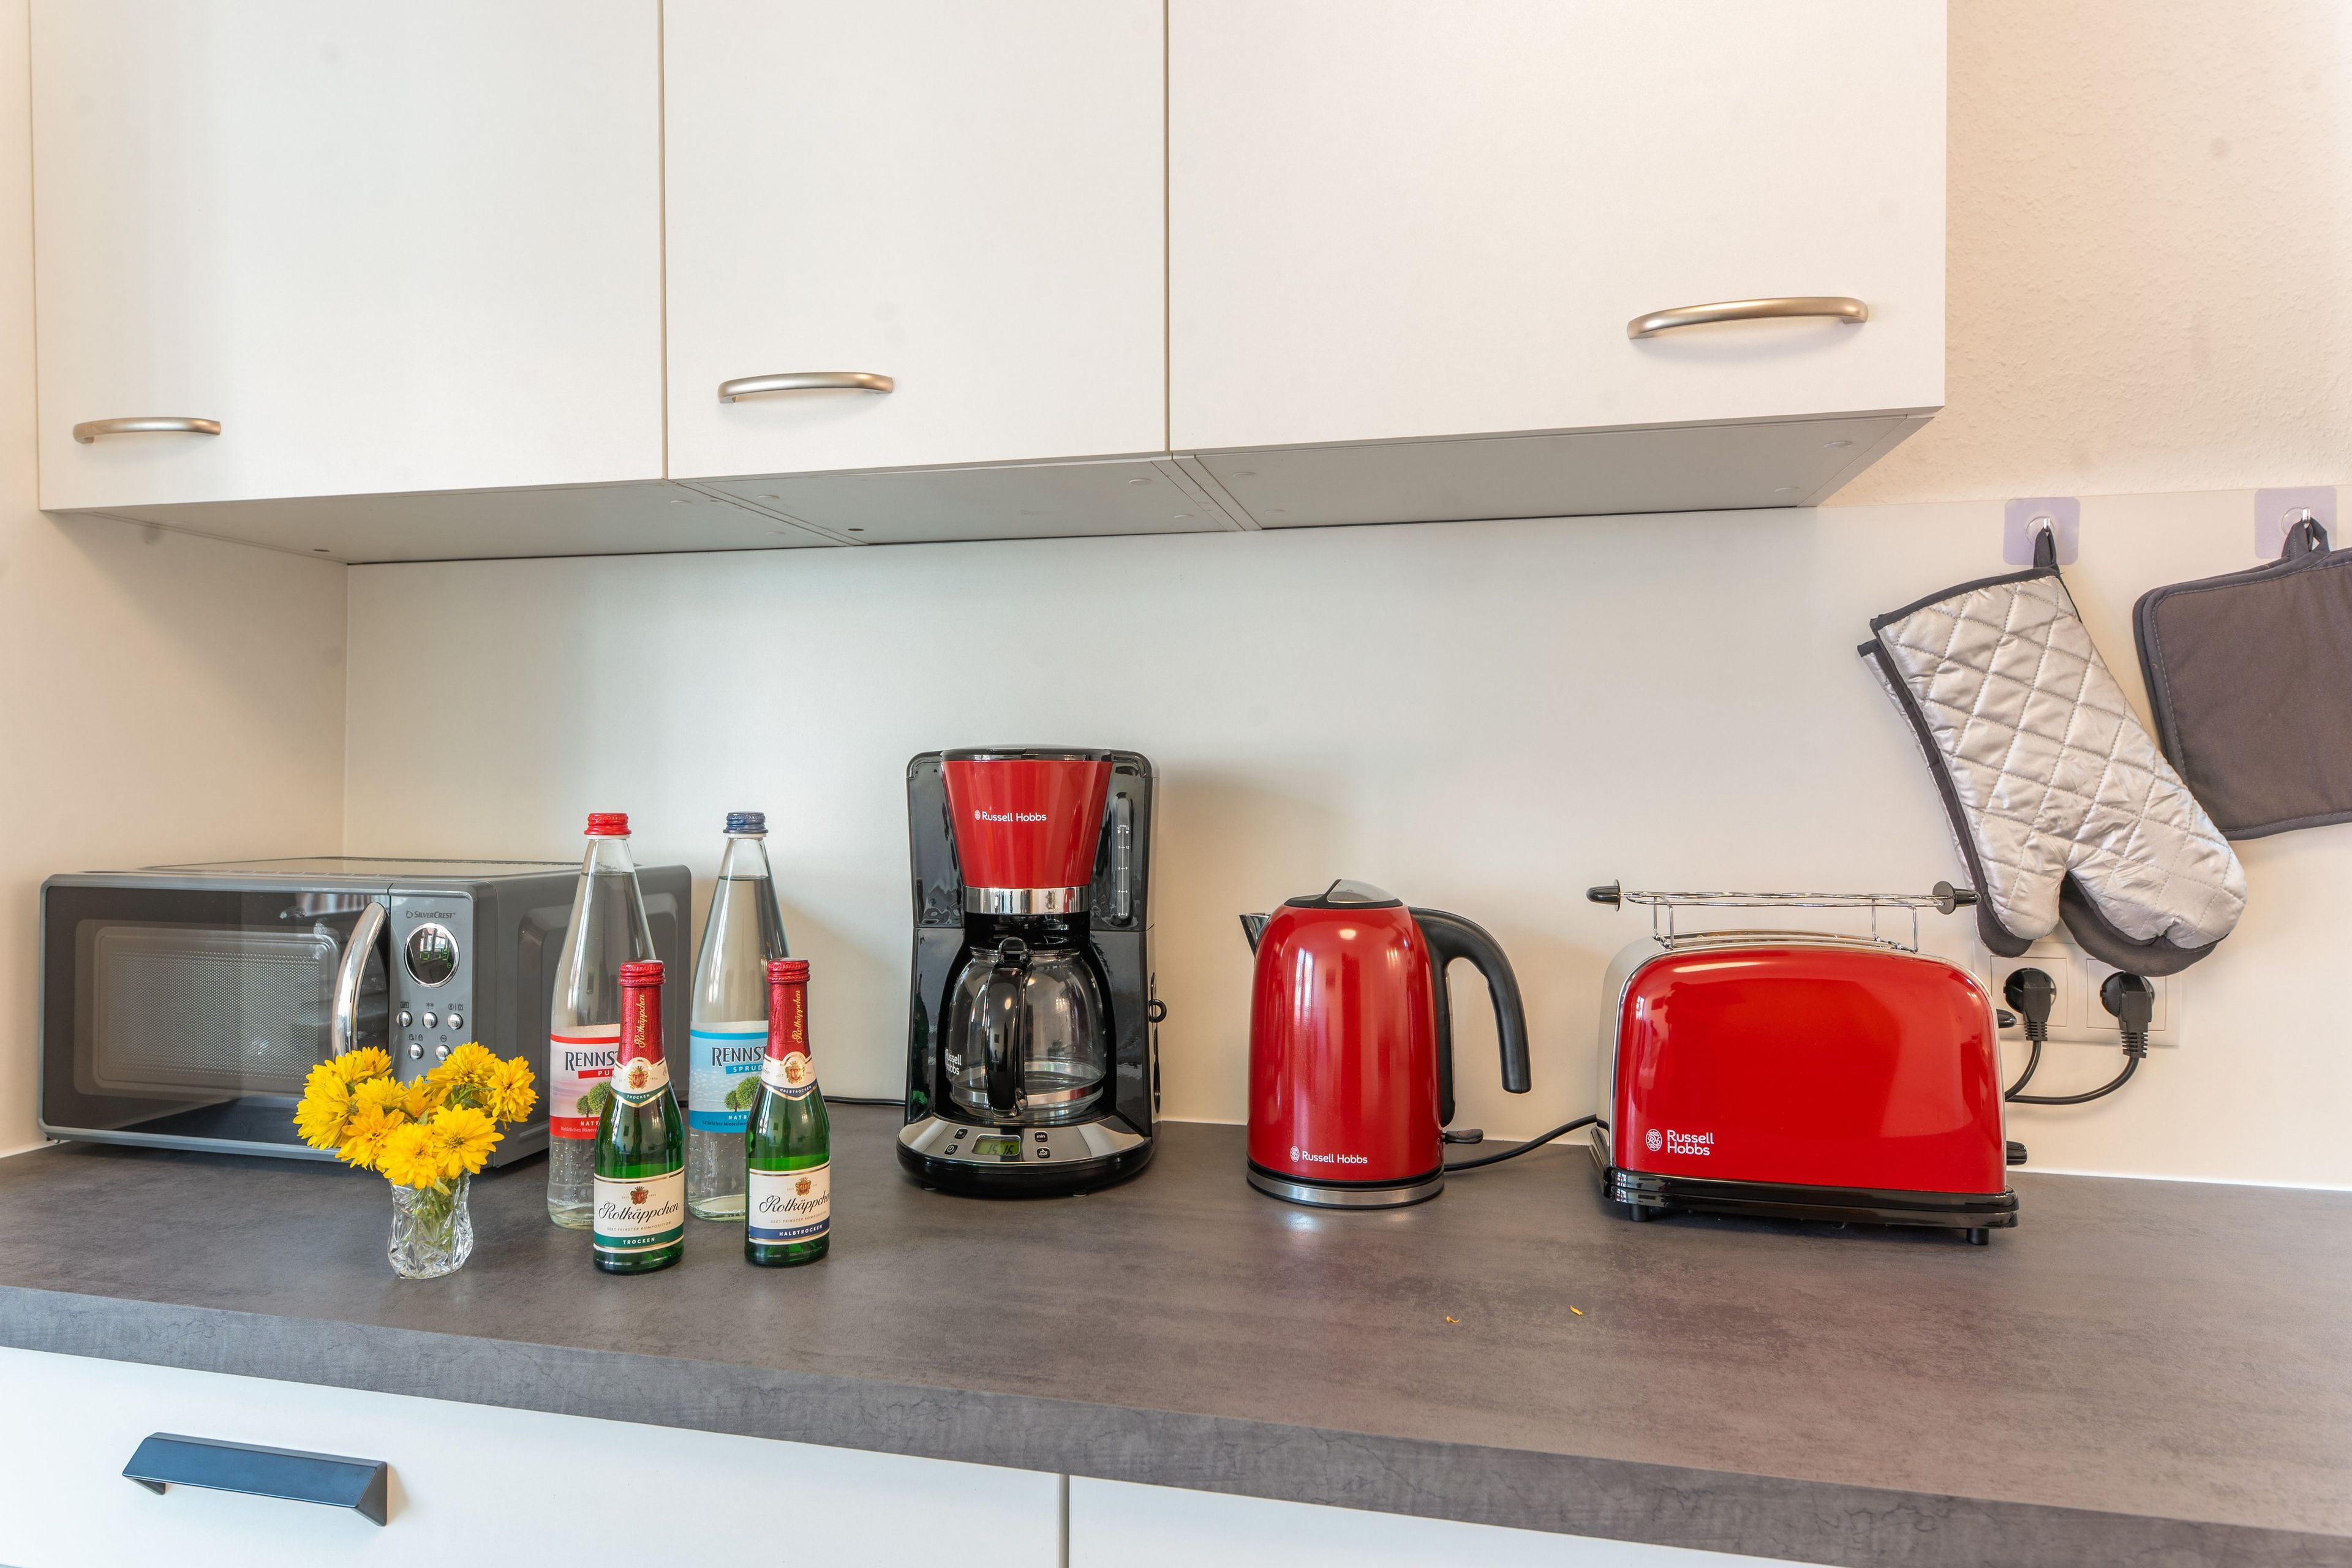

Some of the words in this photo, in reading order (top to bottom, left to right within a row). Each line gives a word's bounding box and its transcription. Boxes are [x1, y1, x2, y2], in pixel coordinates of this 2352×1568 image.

[982, 811, 1013, 821] Russell
[1016, 812, 1047, 822] Hobbs
[633, 993, 648, 1049] Rotkäppchen
[791, 989, 804, 1044] Rotkäppchen
[1667, 1129, 1714, 1144] Russell
[1667, 1141, 1710, 1156] Hobbs
[1302, 1150, 1335, 1163] Russell
[1337, 1154, 1368, 1164] Hobbs
[759, 1190, 830, 1214] Rotkäppche
[598, 1200, 679, 1224] Rotkäppchen
[641, 1221, 671, 1230] KOMPOSITION
[779, 1224, 823, 1237] HALBTROCKEN
